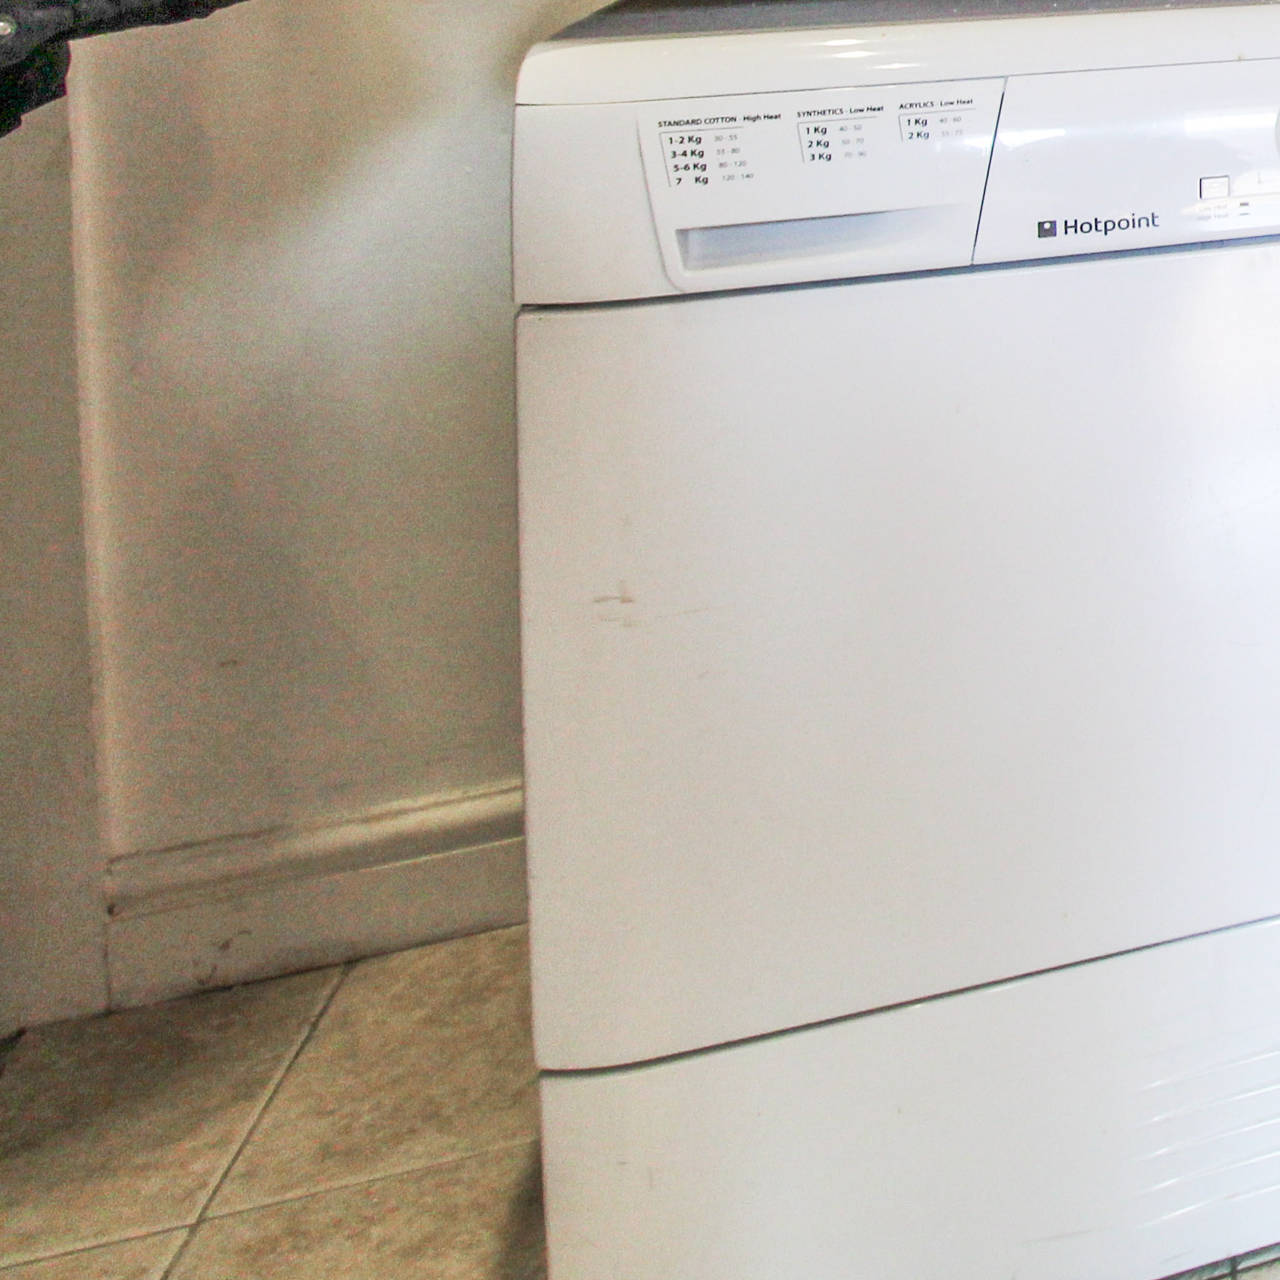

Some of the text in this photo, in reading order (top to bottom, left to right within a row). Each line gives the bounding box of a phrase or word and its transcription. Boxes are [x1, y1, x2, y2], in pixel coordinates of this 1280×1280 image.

[899, 101, 934, 110] ACRYLICS
[797, 108, 844, 118] SYNTHETICS
[850, 106, 865, 114] Low
[658, 118, 702, 128] STANDARD
[704, 116, 737, 125] COTTON
[743, 114, 761, 122] High
[907, 119, 911, 127] 1
[914, 118, 928, 127] Kg
[806, 127, 810, 135] 1
[814, 126, 827, 135] Kg
[908, 132, 913, 140] 2
[916, 131, 929, 140] Kg
[669, 136, 685, 145] 1-2
[688, 135, 702, 145] Kg
[808, 140, 813, 149] 2
[816, 139, 829, 149] Kg
[671, 150, 687, 159] 3-4
[690, 149, 704, 158] Kg
[810, 153, 815, 162] 3
[818, 152, 832, 161] Kg
[673, 163, 690, 172] 5-6
[693, 162, 707, 172] Kg
[675, 177, 682, 186] 7
[695, 176, 709, 185] Kg
[1063, 211, 1160, 237] Hotpoint
